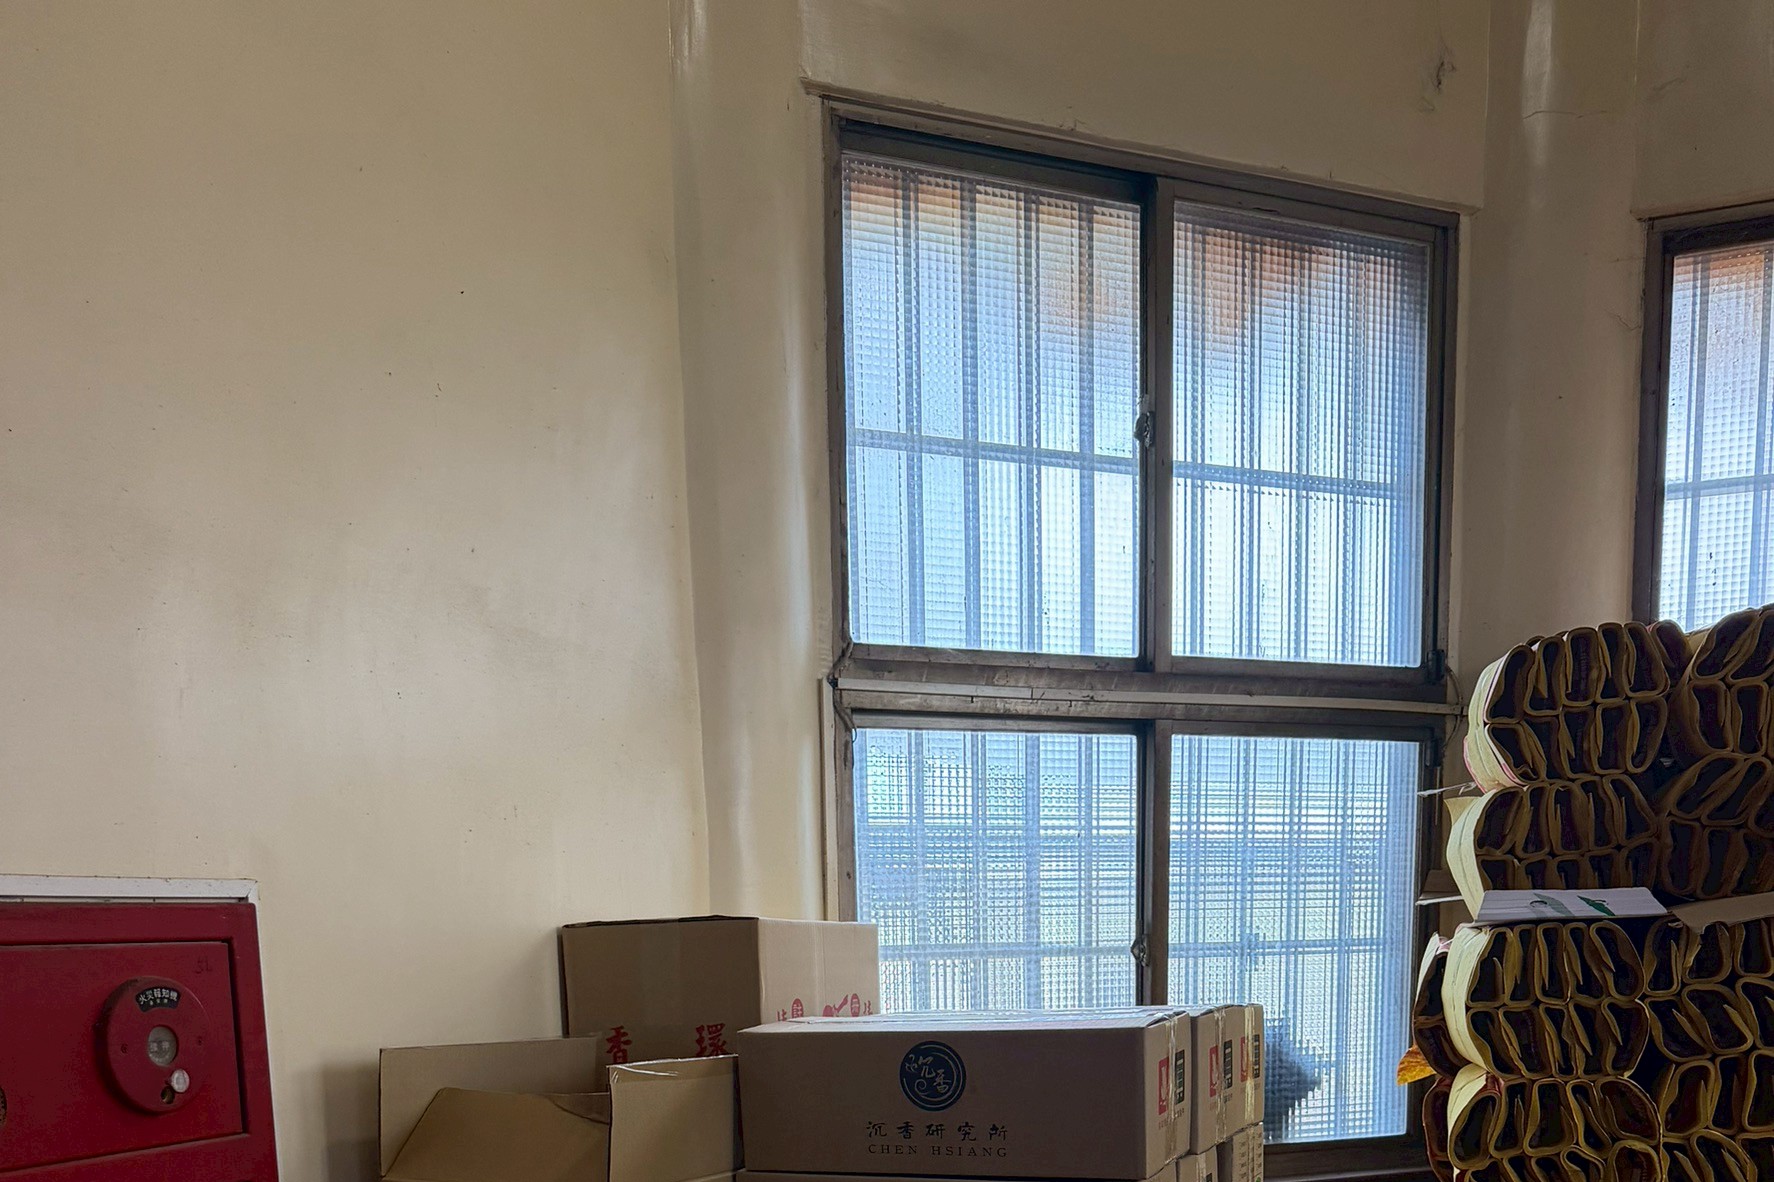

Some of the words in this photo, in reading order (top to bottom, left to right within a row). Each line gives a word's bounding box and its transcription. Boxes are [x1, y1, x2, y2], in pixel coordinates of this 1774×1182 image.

[866, 1121, 1008, 1142] 沉香研究所
[868, 1144, 918, 1155] CHEN
[931, 1145, 1008, 1158] HSIANG
